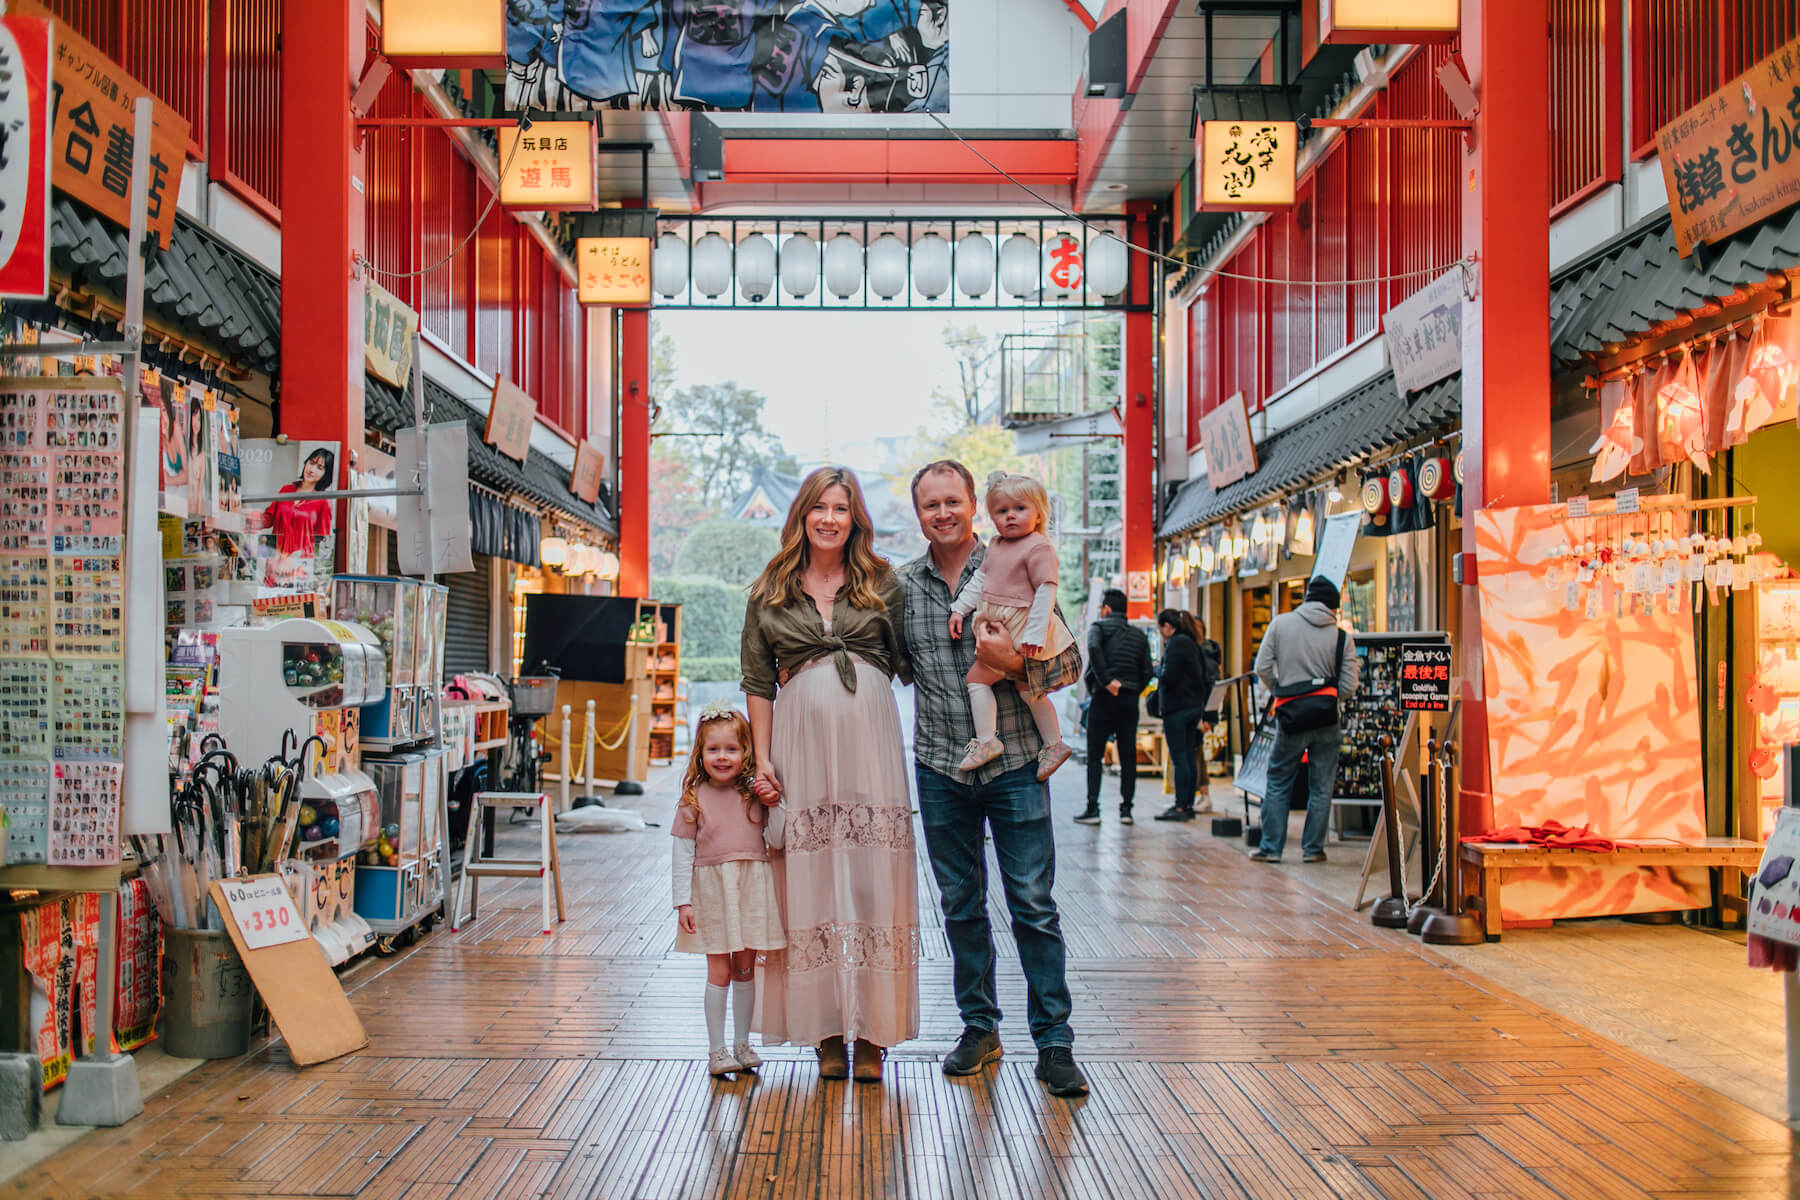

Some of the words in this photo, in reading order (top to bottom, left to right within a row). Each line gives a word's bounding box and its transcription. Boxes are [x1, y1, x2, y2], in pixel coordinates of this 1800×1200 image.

[52, 79, 169, 220] 合書店
[522, 137, 568, 151] 玩具店
[520, 167, 572, 188] 遊馬
[585, 272, 646, 288] ささごや
[1403, 649, 1452, 662] 金魚すくい
[1403, 664, 1448, 680] 最後尾
[1405, 700, 1418, 708] End
